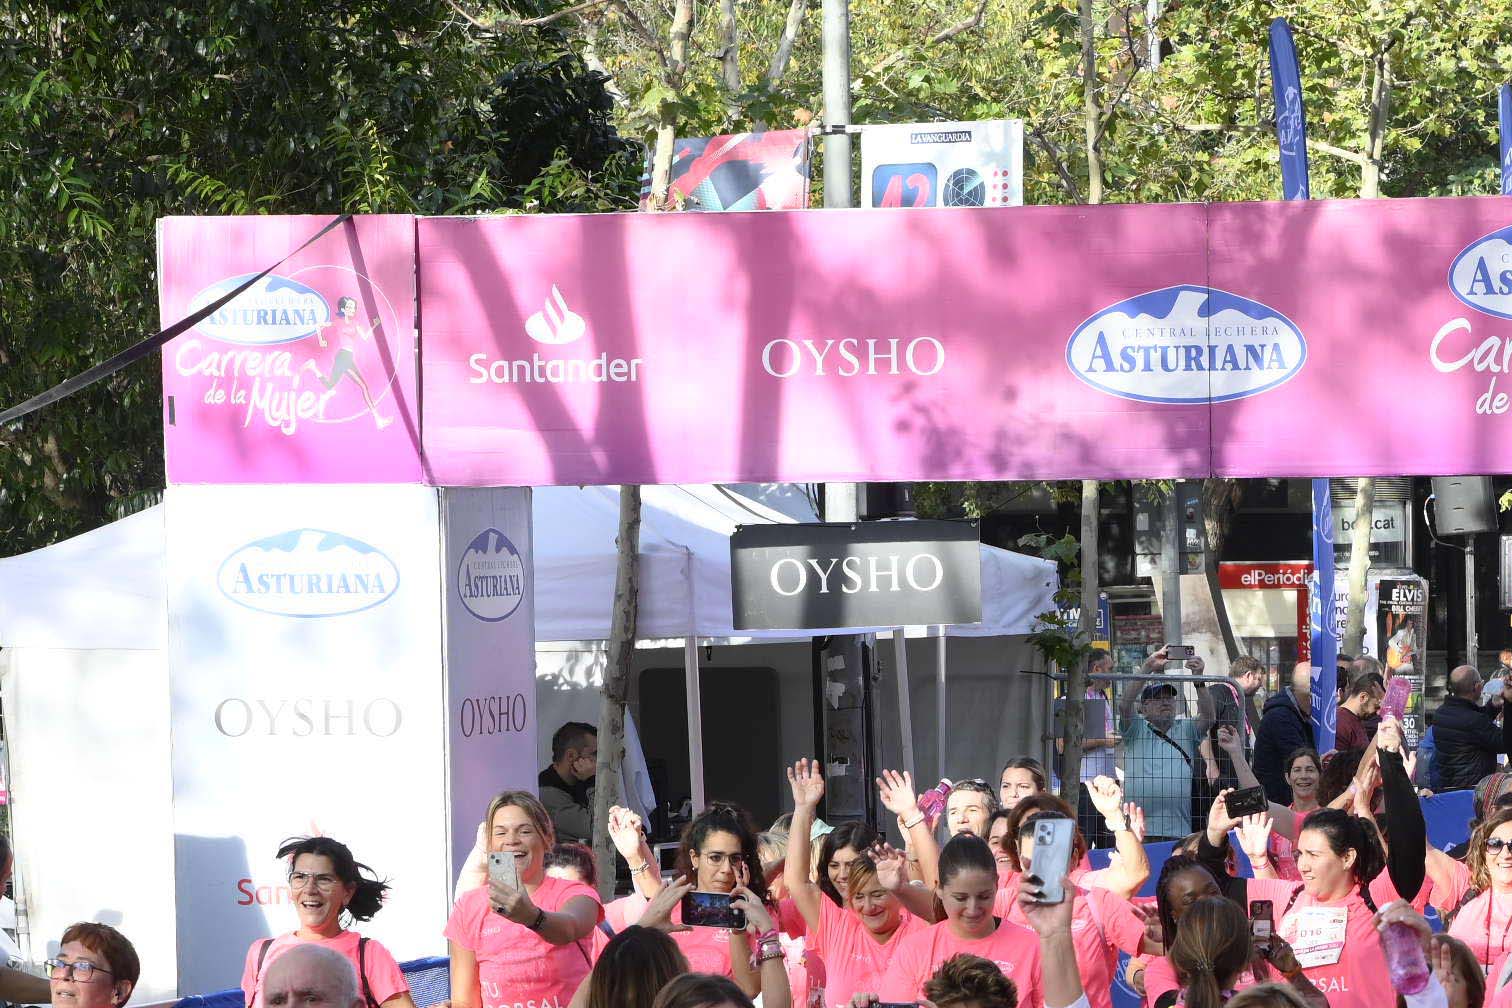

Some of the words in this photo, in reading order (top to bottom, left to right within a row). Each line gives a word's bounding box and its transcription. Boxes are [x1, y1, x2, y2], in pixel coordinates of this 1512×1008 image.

[921, 132, 971, 143] VANGUARDIA
[1121, 326, 1199, 337] CENTRAL
[1203, 326, 1280, 337] LECHERA
[176, 339, 293, 377] Carrera
[469, 352, 642, 384] Santander
[762, 337, 945, 379] OYSHO
[1085, 330, 1289, 374] ASTURIANA
[204, 382, 226, 405] de
[230, 382, 247, 405] la
[244, 375, 337, 436] Mujer
[1475, 376, 1510, 416] de
[232, 562, 386, 595] ASTURIANA
[463, 563, 521, 599] ASTURIANA
[769, 553, 945, 597] OYSHO
[1391, 588, 1424, 601] ELVIS
[213, 696, 403, 739] OYSHO
[460, 693, 527, 739] OYSHO
